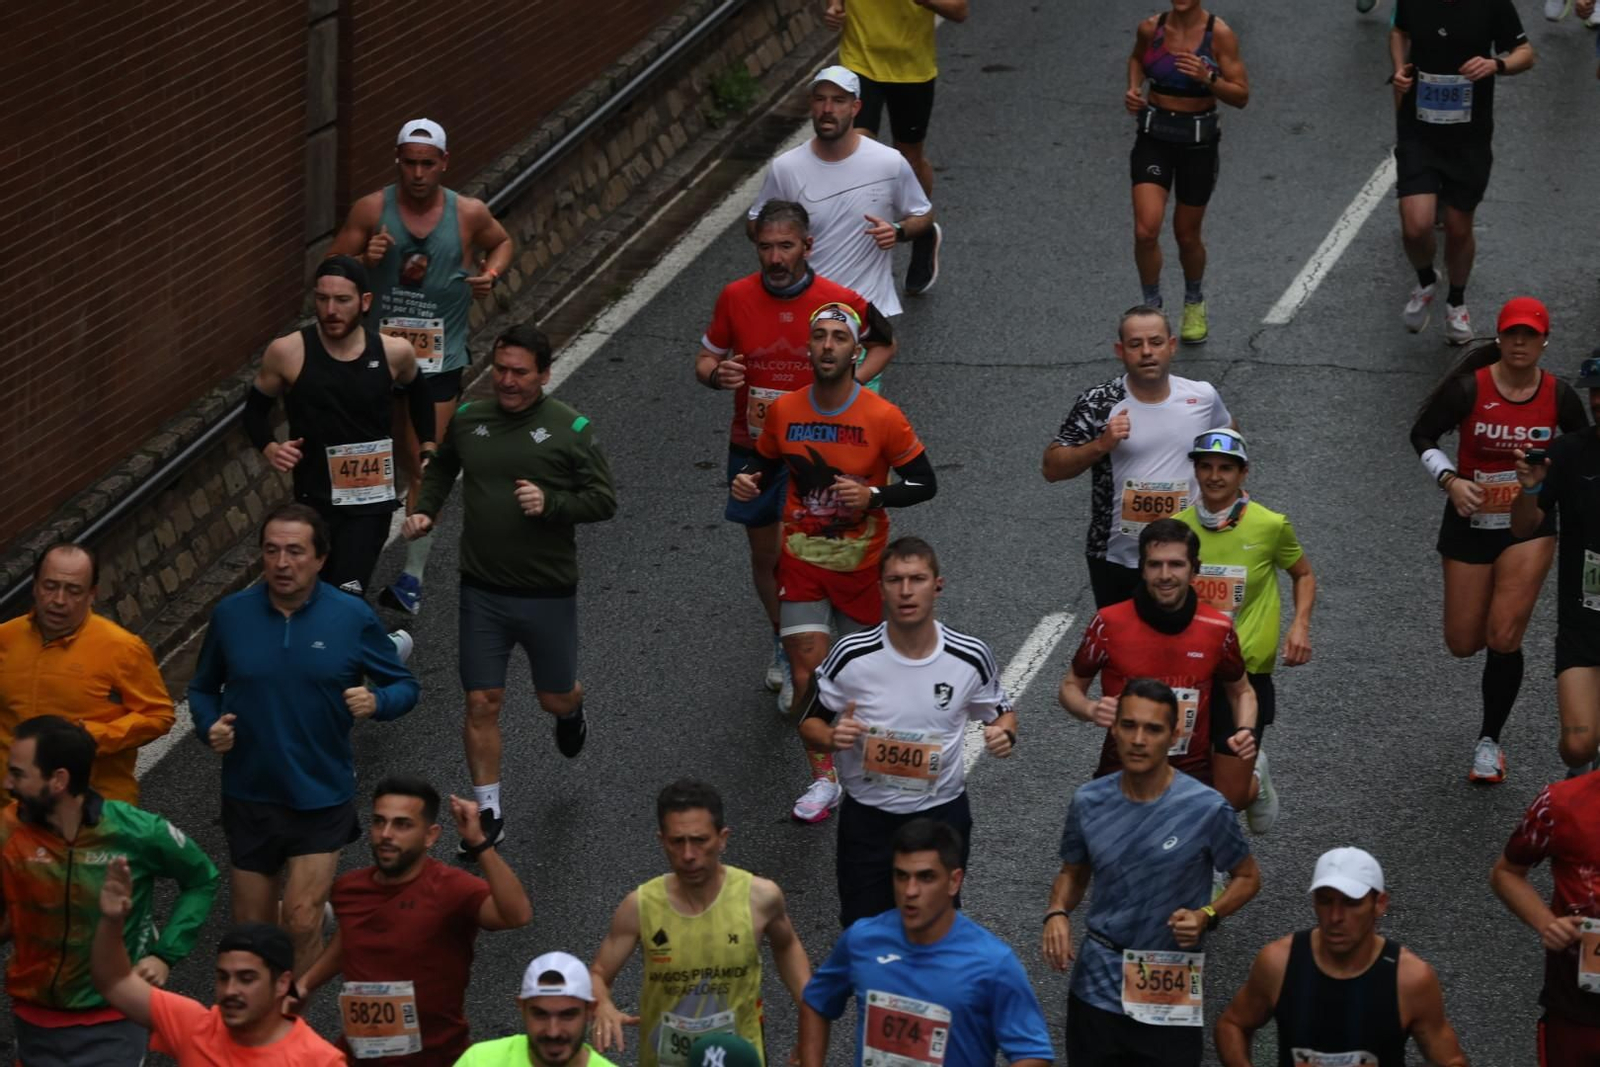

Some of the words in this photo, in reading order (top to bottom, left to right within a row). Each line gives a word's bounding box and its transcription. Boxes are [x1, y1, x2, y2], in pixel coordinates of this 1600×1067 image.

[1424, 86, 1460, 102] 2198
[391, 287, 425, 299] Siempre
[772, 373, 795, 382] 2022
[786, 424, 838, 443] DRAGON
[838, 426, 869, 447] BALL
[340, 457, 380, 477] 4744
[1132, 495, 1174, 513] 5669
[1191, 580, 1228, 600] 209
[875, 743, 923, 768] 3540
[1135, 969, 1185, 992] 3564
[350, 1002, 396, 1024] 5820
[883, 1015, 922, 1043] 674
